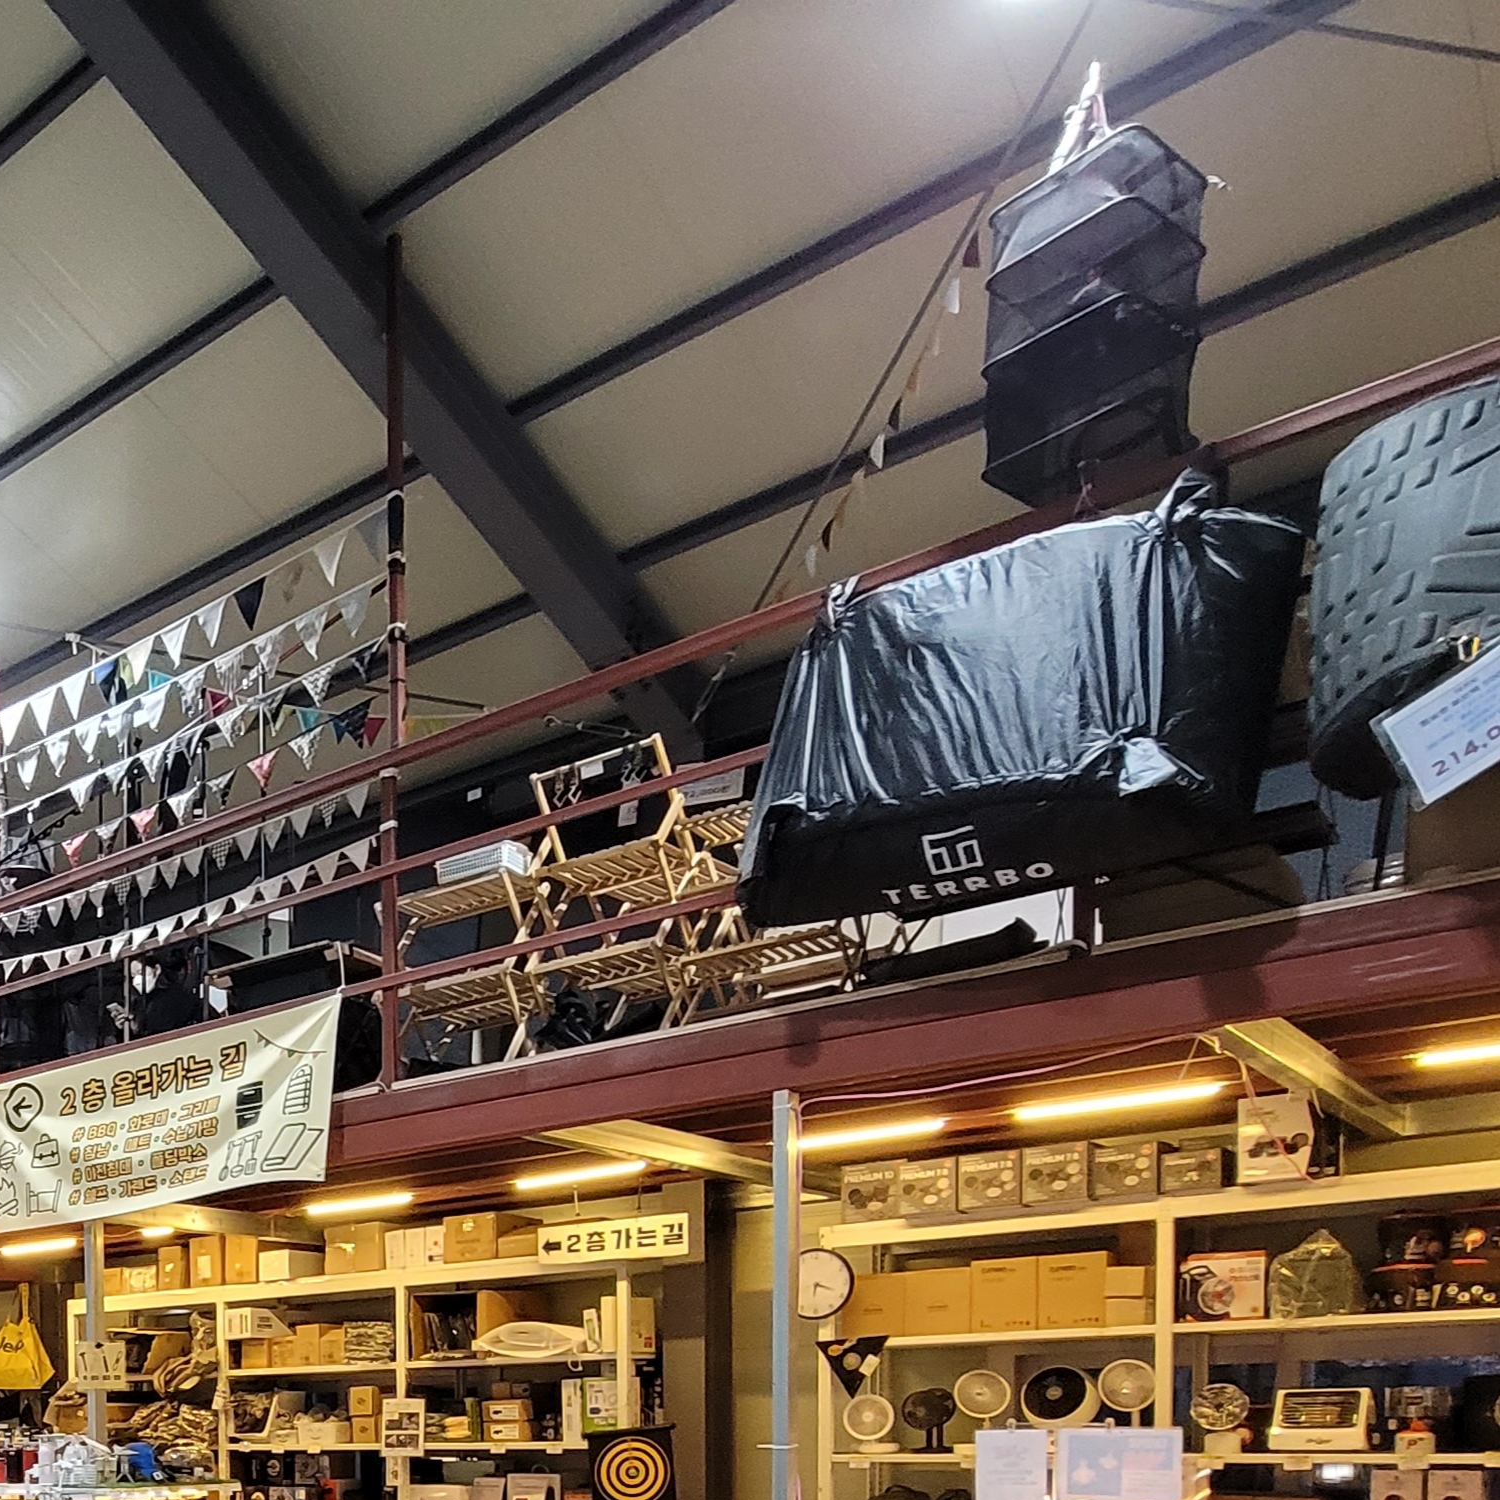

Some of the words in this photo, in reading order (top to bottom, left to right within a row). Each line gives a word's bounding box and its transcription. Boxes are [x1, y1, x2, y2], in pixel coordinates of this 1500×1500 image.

[881, 862, 1055, 905] TERRBO
[110, 1055, 214, 1108] 올라가는
[219, 1041, 247, 1081] 길
[87, 1122, 117, 1140] BBQ
[127, 1109, 169, 1132] 화로대
[162, 1117, 219, 1144] 수납가방
